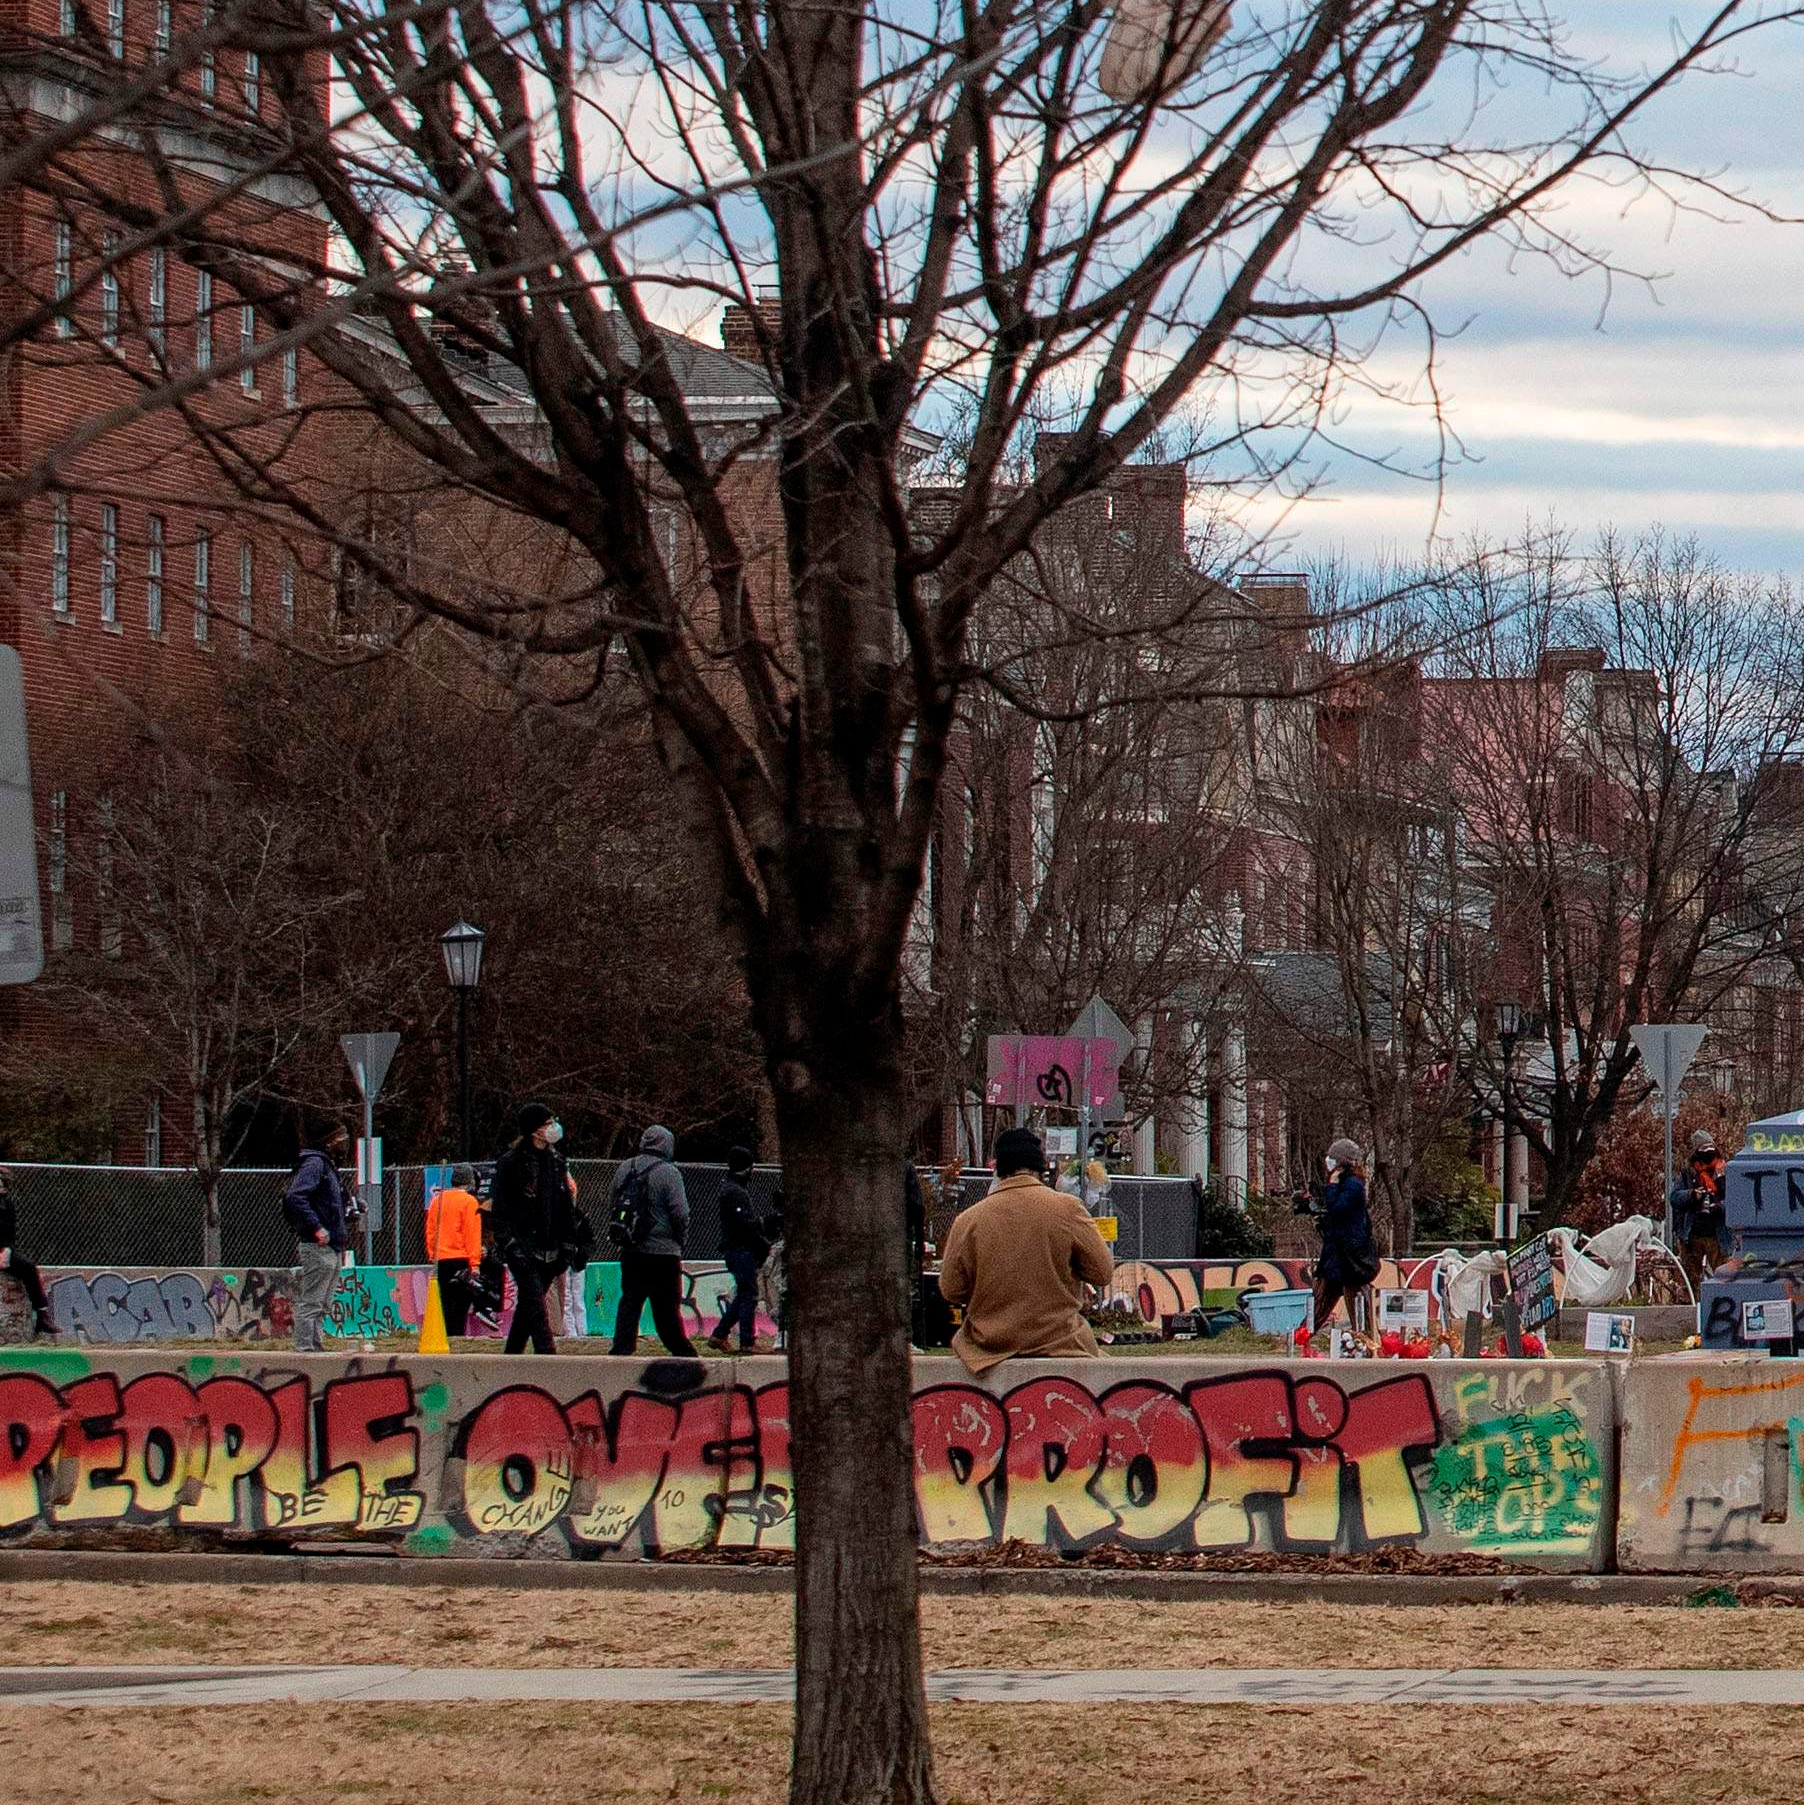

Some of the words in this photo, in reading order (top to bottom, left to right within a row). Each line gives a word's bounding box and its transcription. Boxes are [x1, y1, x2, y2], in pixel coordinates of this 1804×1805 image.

[49, 1271, 219, 1344] ACAB
[0, 1371, 424, 1529] PEOPLE
[276, 1491, 331, 1528] BE
[364, 1493, 413, 1527] THE
[583, 1516, 637, 1538] WANT
